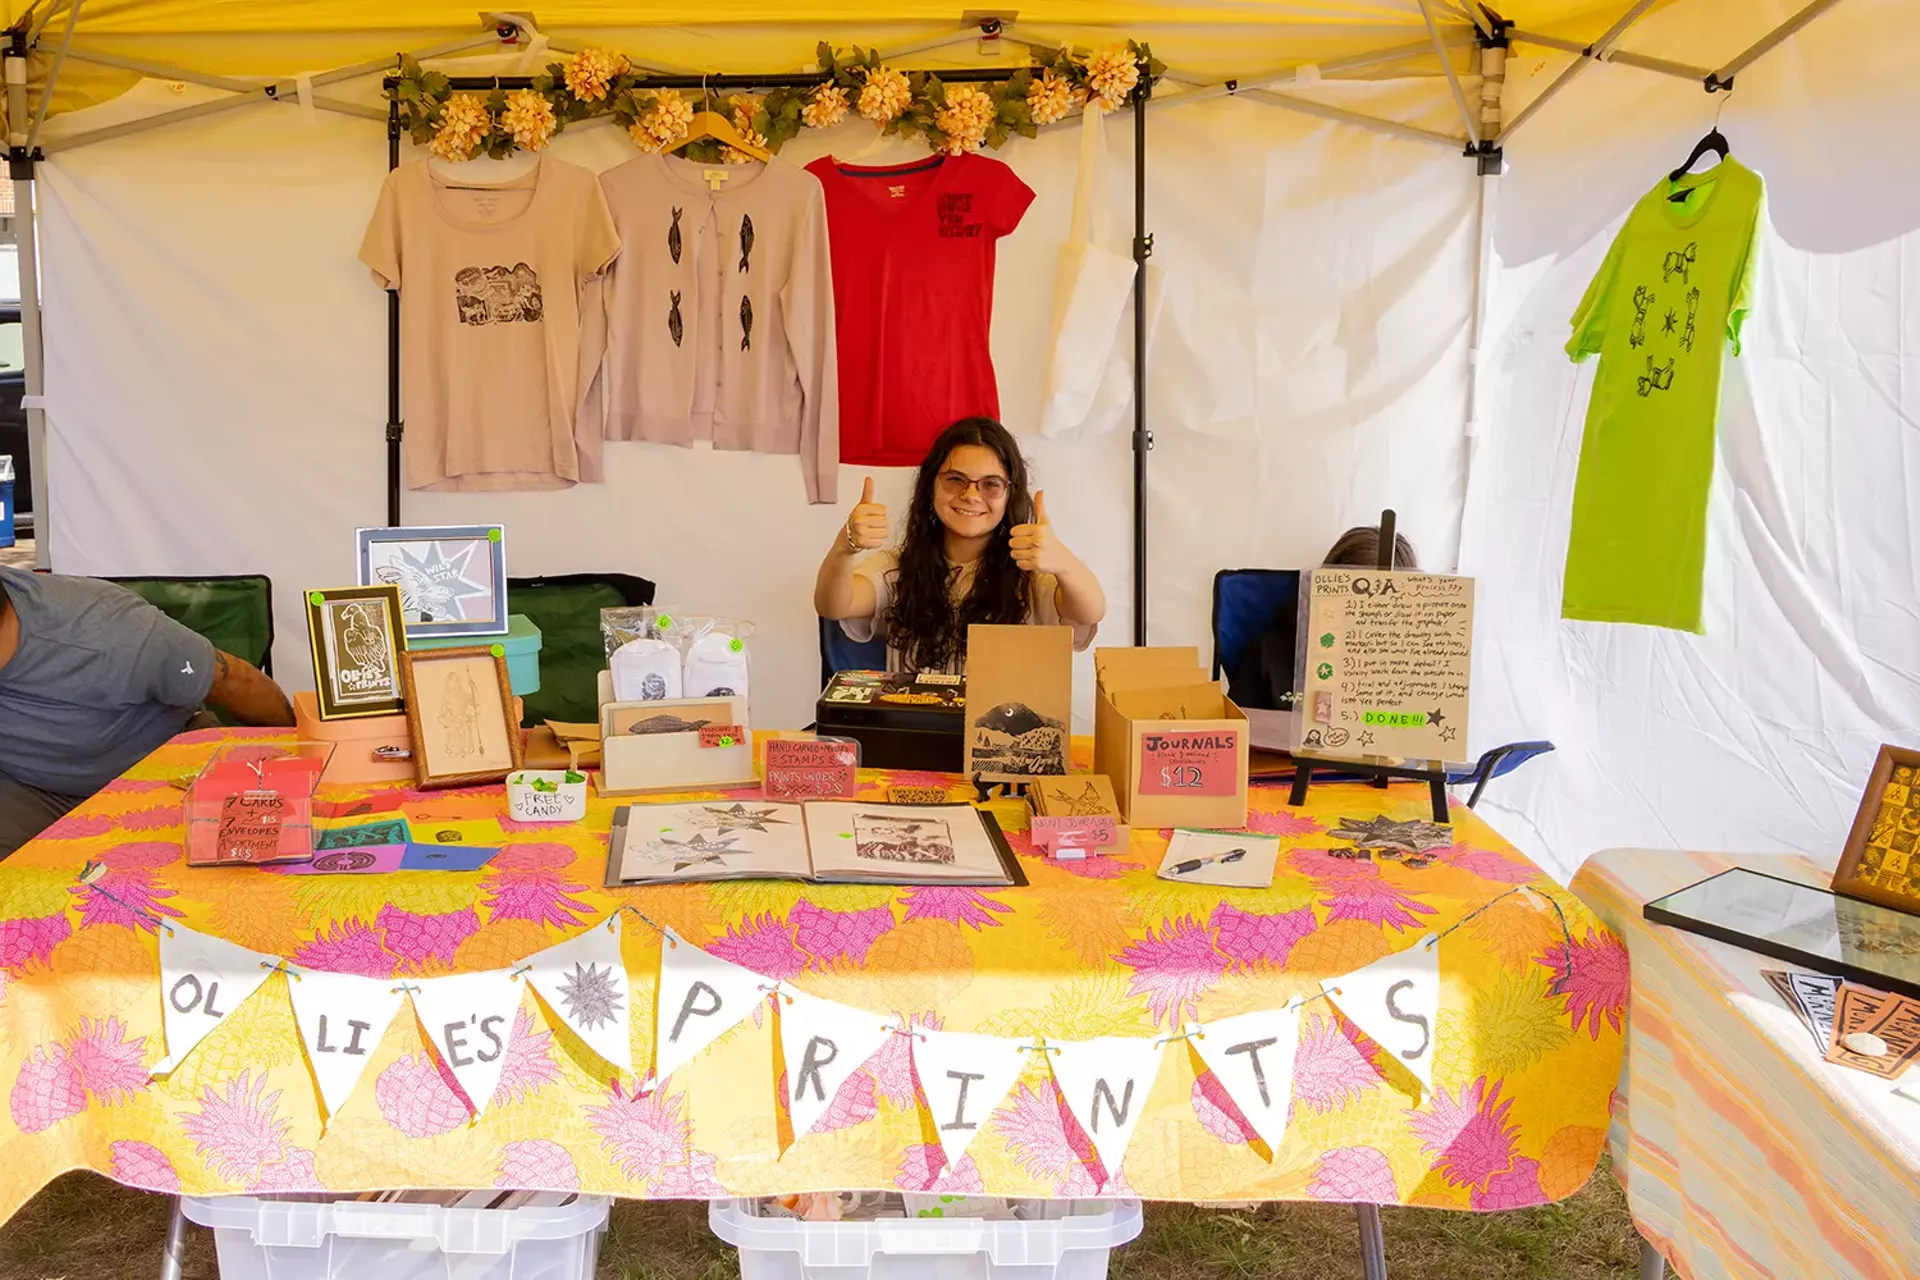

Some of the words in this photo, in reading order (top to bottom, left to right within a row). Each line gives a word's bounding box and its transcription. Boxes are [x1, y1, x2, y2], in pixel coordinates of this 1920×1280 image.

[1315, 573, 1350, 584] OLLIE'S
[1316, 584, 1349, 595] PRINTS
[1146, 735, 1235, 752] JOURNALS
[781, 754, 826, 765] STAMPS
[1160, 766, 1204, 788] $12
[225, 796, 239, 808] 7
[240, 797, 285, 809] CARDS
[524, 791, 562, 806] FREE
[525, 804, 563, 817] CANDY
[223, 816, 236, 828] 7
[261, 815, 277, 825] $15
[1035, 818, 1061, 829] MINI
[219, 827, 280, 838] ENVELOPES
[1091, 828, 1109, 842] $5
[230, 847, 253, 860] $15
